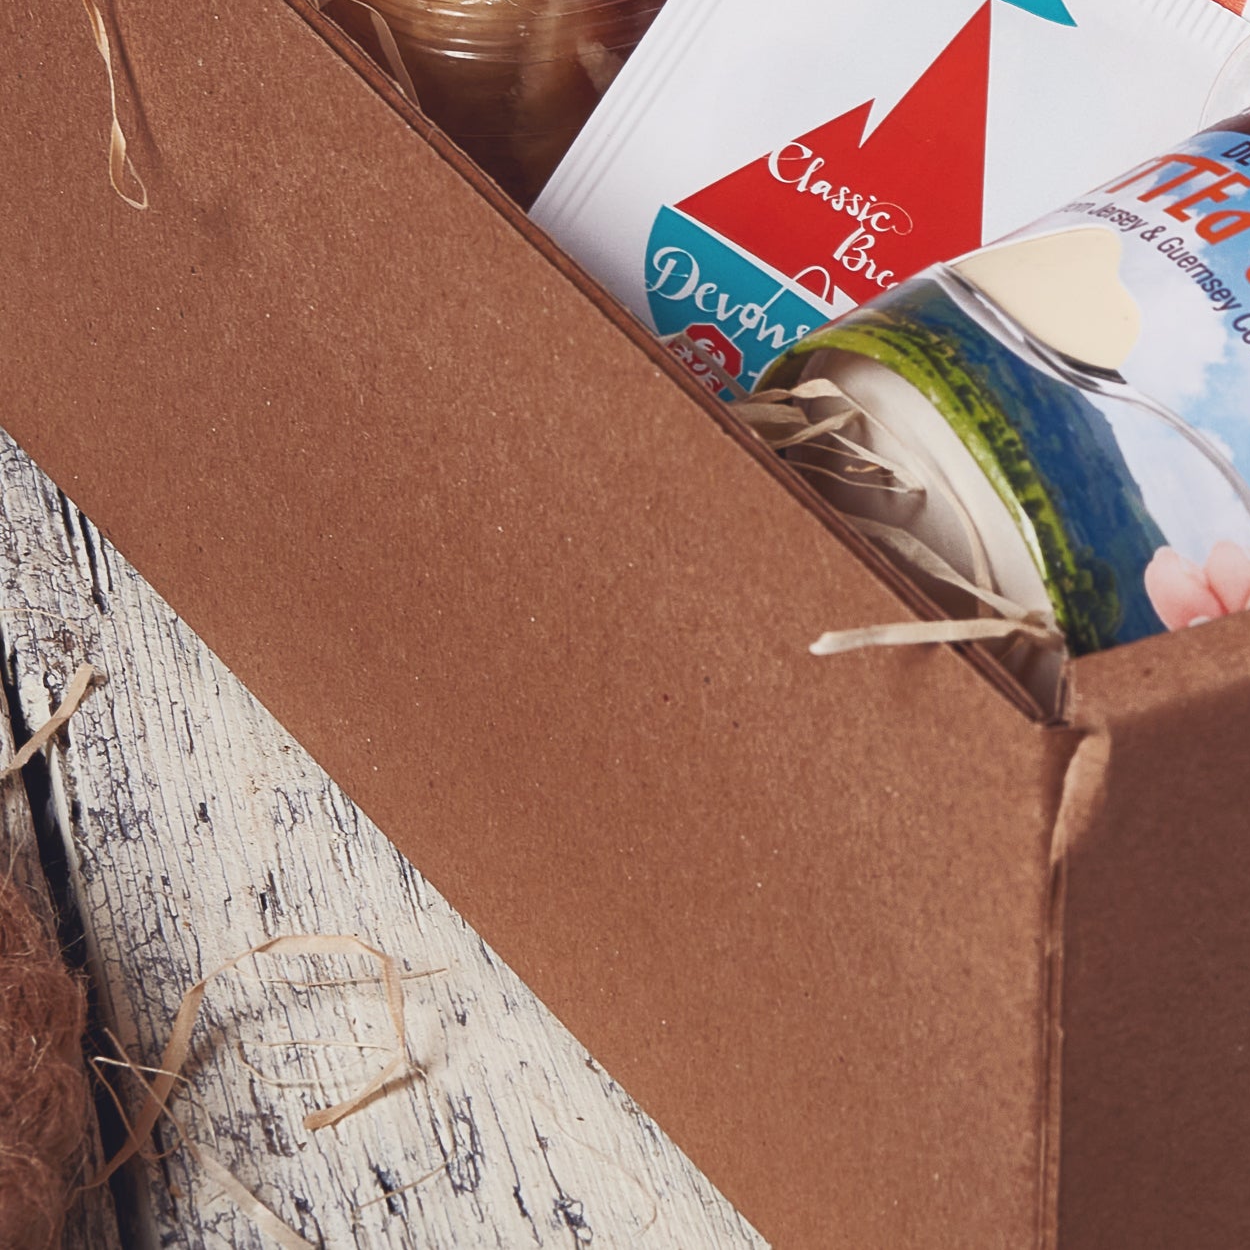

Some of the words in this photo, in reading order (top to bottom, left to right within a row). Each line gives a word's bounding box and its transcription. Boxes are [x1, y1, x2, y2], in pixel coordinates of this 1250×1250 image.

[767, 141, 913, 235] Classic
[833, 225, 899, 290] Bre
[1088, 202, 1148, 232] Jersey
[1140, 225, 1166, 242] &
[1157, 236, 1242, 311] Guernsey
